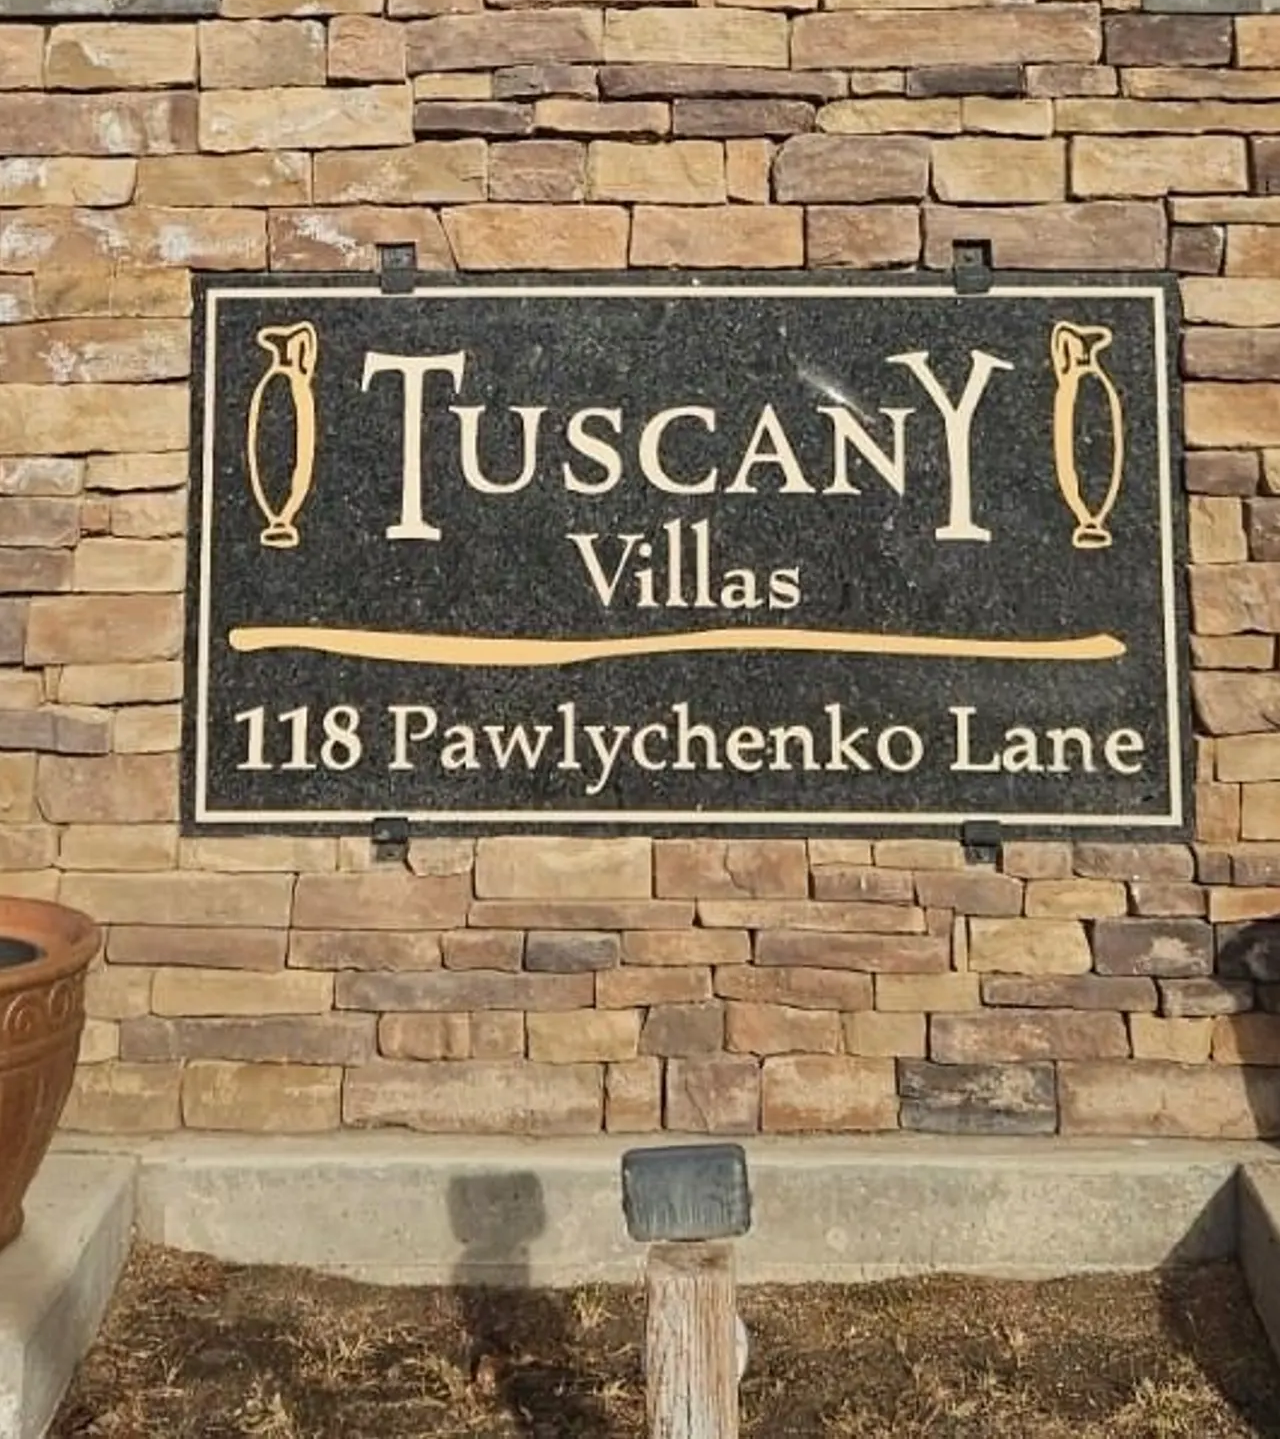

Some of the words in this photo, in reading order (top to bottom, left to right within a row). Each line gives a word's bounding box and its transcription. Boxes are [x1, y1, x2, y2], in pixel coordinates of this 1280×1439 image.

[360, 349, 1015, 543] TUSCANY
[566, 518, 803, 610] Villas
[233, 705, 363, 772] 118
[386, 702, 923, 796] Pawlychenko
[949, 705, 1145, 775] Lane
